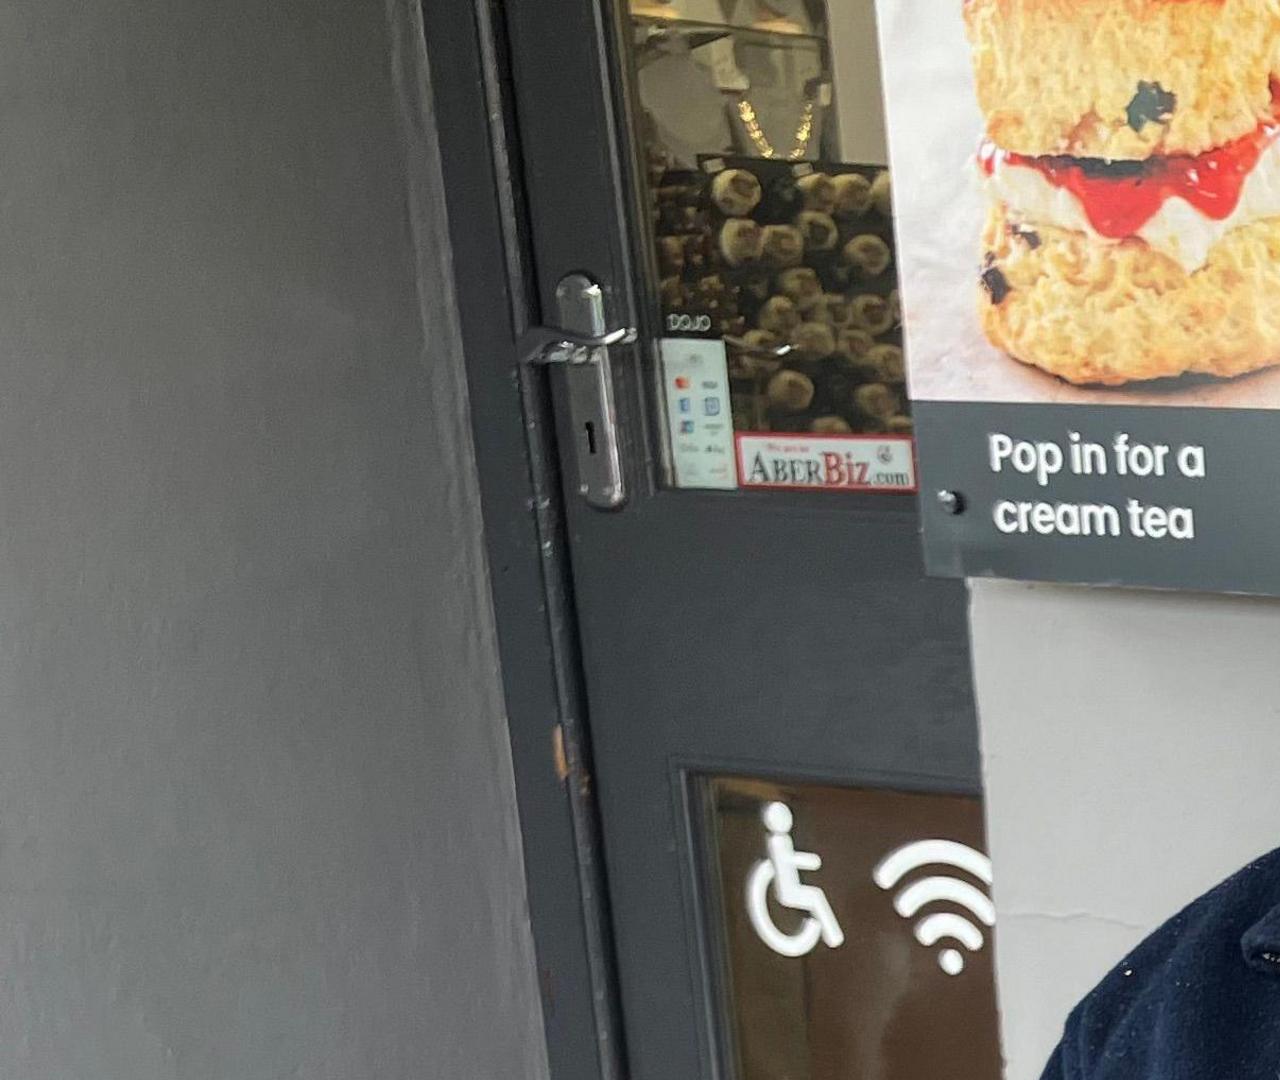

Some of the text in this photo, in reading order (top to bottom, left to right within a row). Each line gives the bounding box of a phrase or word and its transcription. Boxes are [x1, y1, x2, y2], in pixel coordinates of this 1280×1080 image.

[988, 431, 1206, 487] Pop in for a
[993, 497, 1195, 539] cream tea
